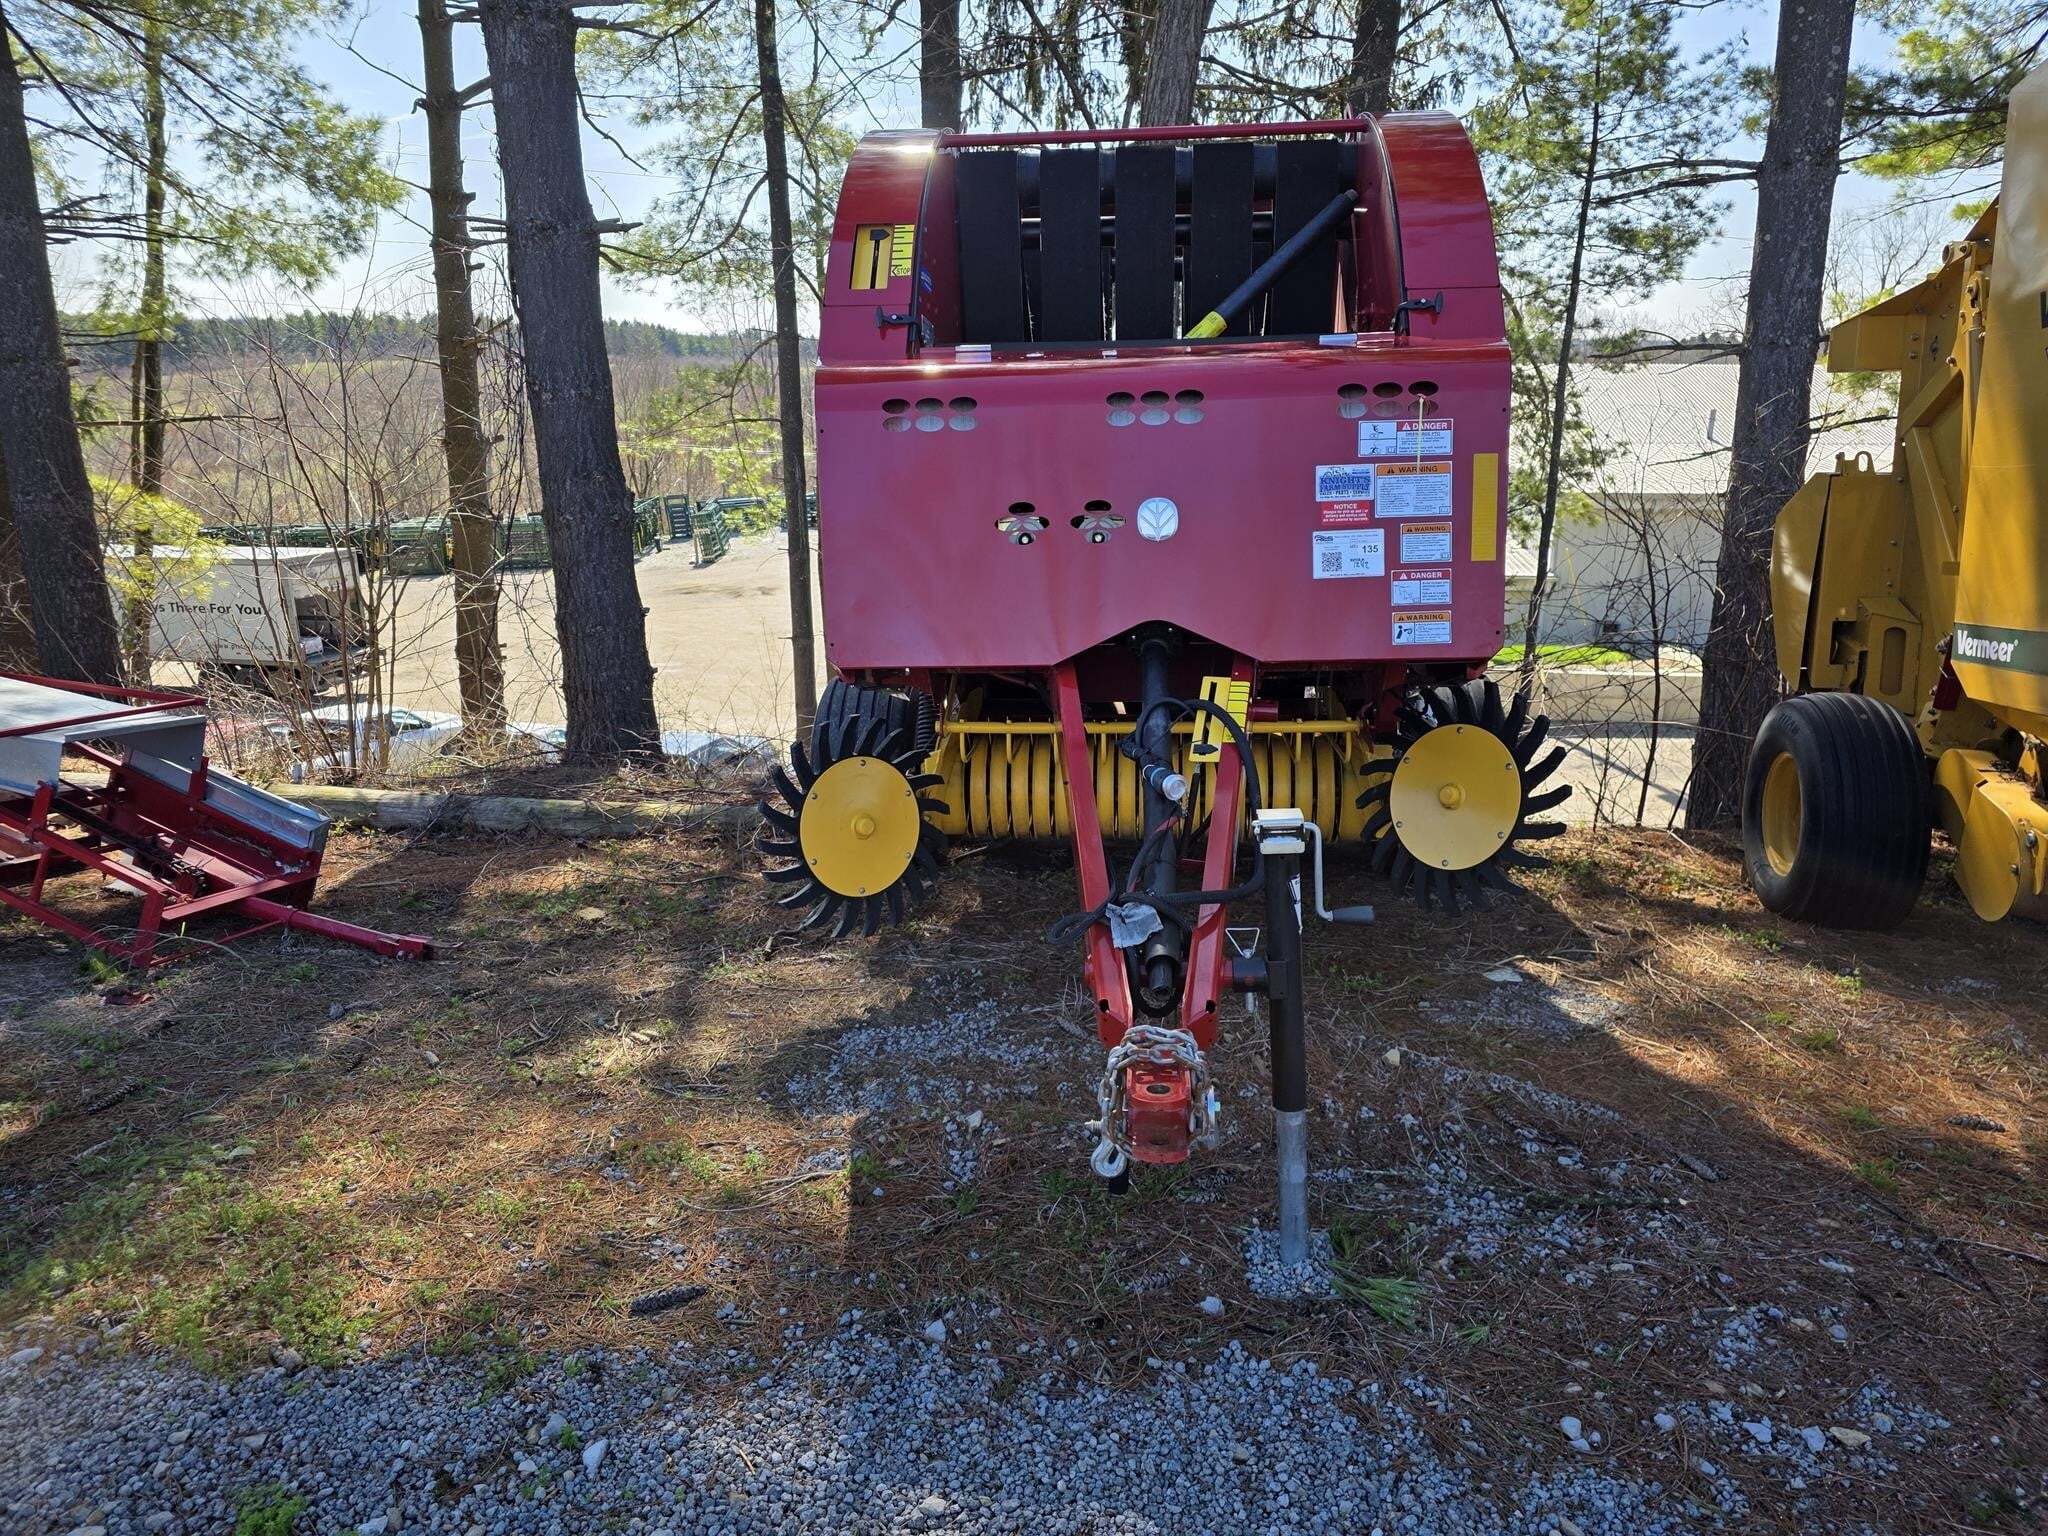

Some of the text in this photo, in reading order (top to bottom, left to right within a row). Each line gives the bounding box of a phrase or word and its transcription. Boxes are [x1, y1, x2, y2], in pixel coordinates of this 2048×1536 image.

[896, 267, 910, 275] STOP
[1398, 465, 1438, 473] WARNING
[1342, 483, 1370, 491] SUPPLY
[1362, 544, 1379, 554] 135
[209, 603, 232, 614] For
[235, 603, 262, 615] You
[1406, 613, 1444, 621] WARNING
[1957, 629, 2015, 662] Vermeer
